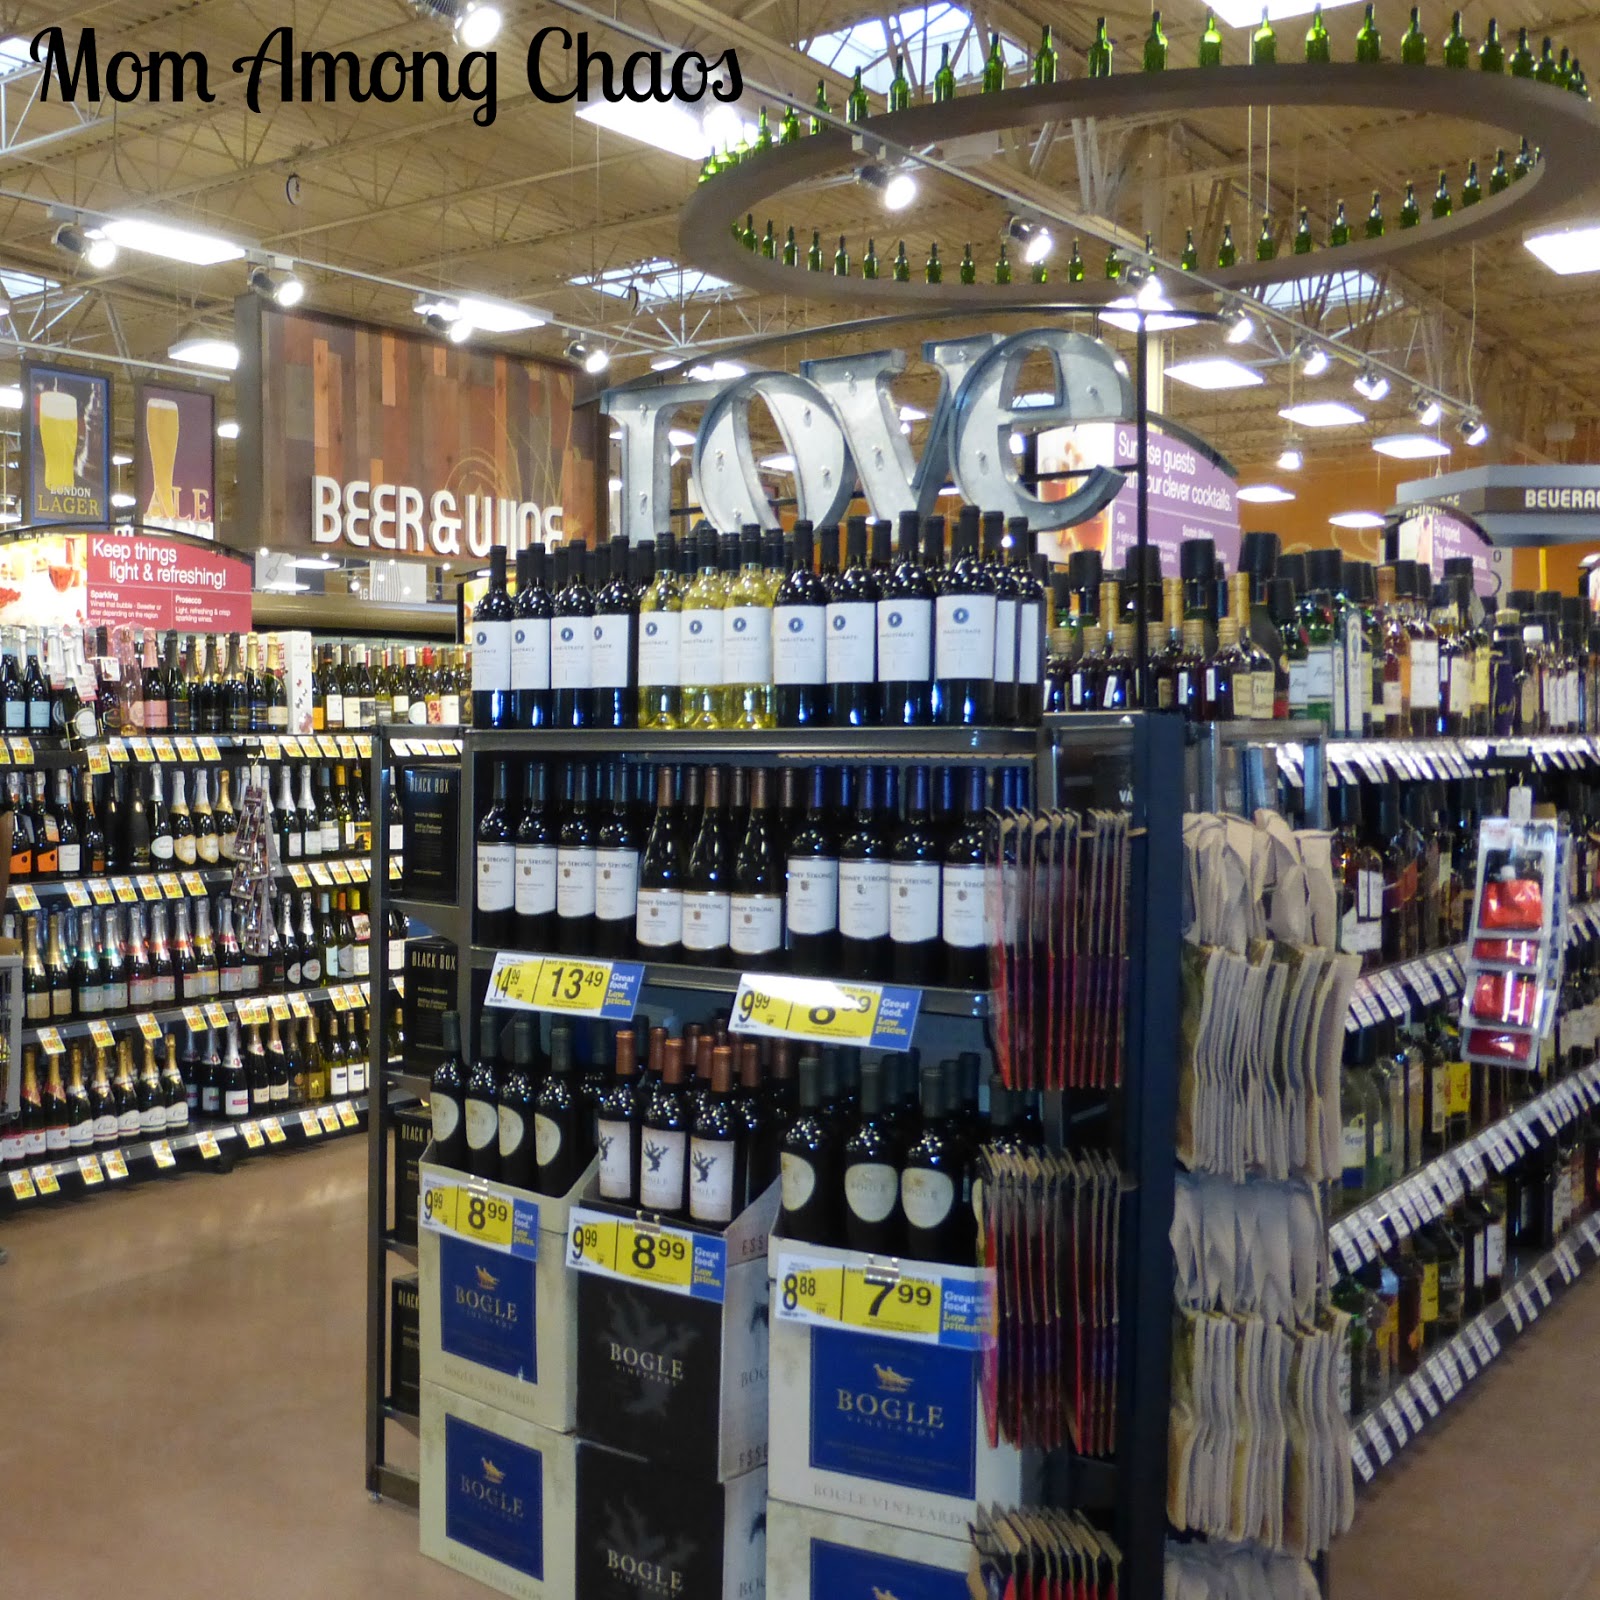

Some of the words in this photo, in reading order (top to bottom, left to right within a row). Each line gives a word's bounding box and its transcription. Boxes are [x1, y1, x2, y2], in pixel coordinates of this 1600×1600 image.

[1118, 431, 1161, 465] Surise
[1163, 449, 1196, 475] guests
[38, 494, 99, 517] LAGER
[50, 485, 91, 498] LONDON
[144, 485, 212, 522] ALE
[1162, 476, 1190, 500] clever
[1191, 484, 1232, 511] cocktails.
[311, 475, 425, 552] BEER
[429, 490, 462, 555] &
[92, 538, 131, 563] Keep
[134, 543, 177, 566] things
[109, 560, 139, 583] light
[142, 563, 153, 582] &
[157, 565, 227, 590] refreshing!
[90, 589, 119, 601] Sparkling
[175, 595, 202, 605] Prosecco
[409, 777, 431, 793] BLACK
[434, 778, 449, 794] BOX
[411, 951, 436, 969] BLACK
[439, 954, 456, 971] BOX
[401, 1123, 424, 1143] BLACK
[455, 1285, 518, 1322] BOGLE
[610, 1342, 684, 1380] BOGLE
[837, 1388, 944, 1429] BOGLE
[461, 1473, 524, 1518] BOGLE
[607, 1549, 683, 1591] BOGLE
